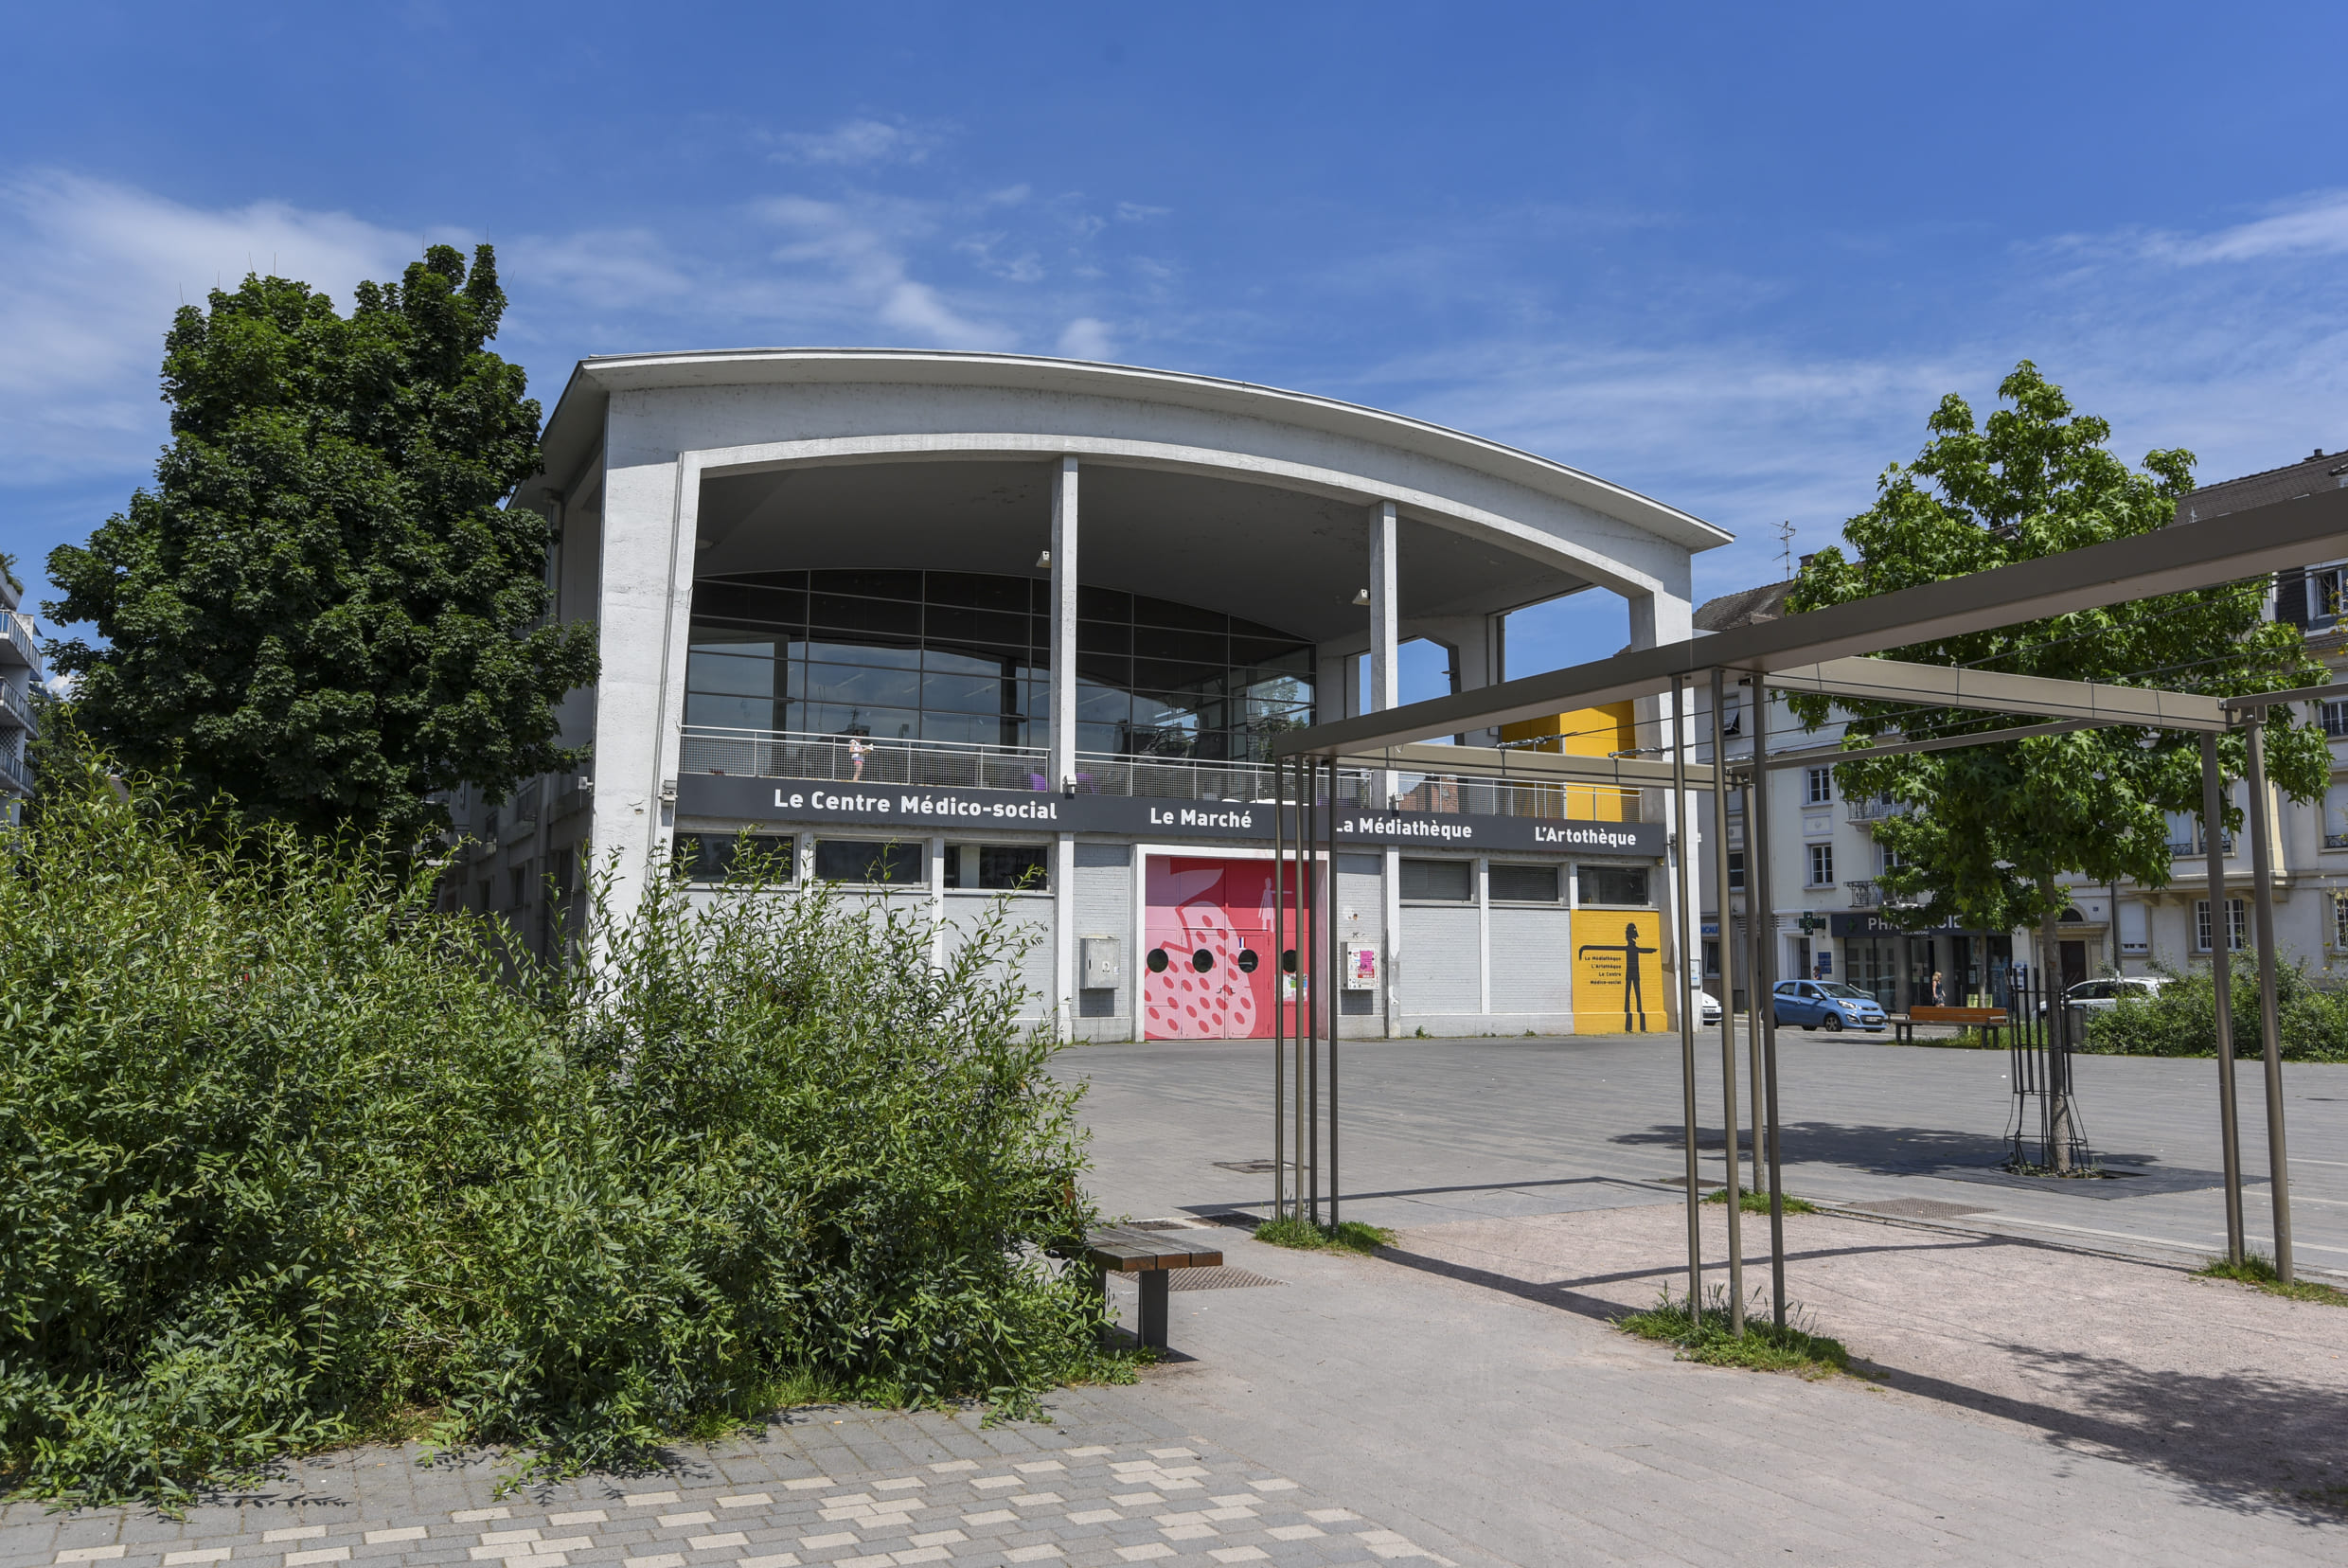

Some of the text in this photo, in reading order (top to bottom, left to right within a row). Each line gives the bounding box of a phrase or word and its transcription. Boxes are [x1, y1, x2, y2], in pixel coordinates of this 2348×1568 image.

[774, 789, 1058, 819] Le Centre Médico-social
[1150, 808, 1253, 829] Le Marché
[1359, 817, 1472, 840] Médiathèque
[1535, 826, 1637, 847] L'Artothèque
